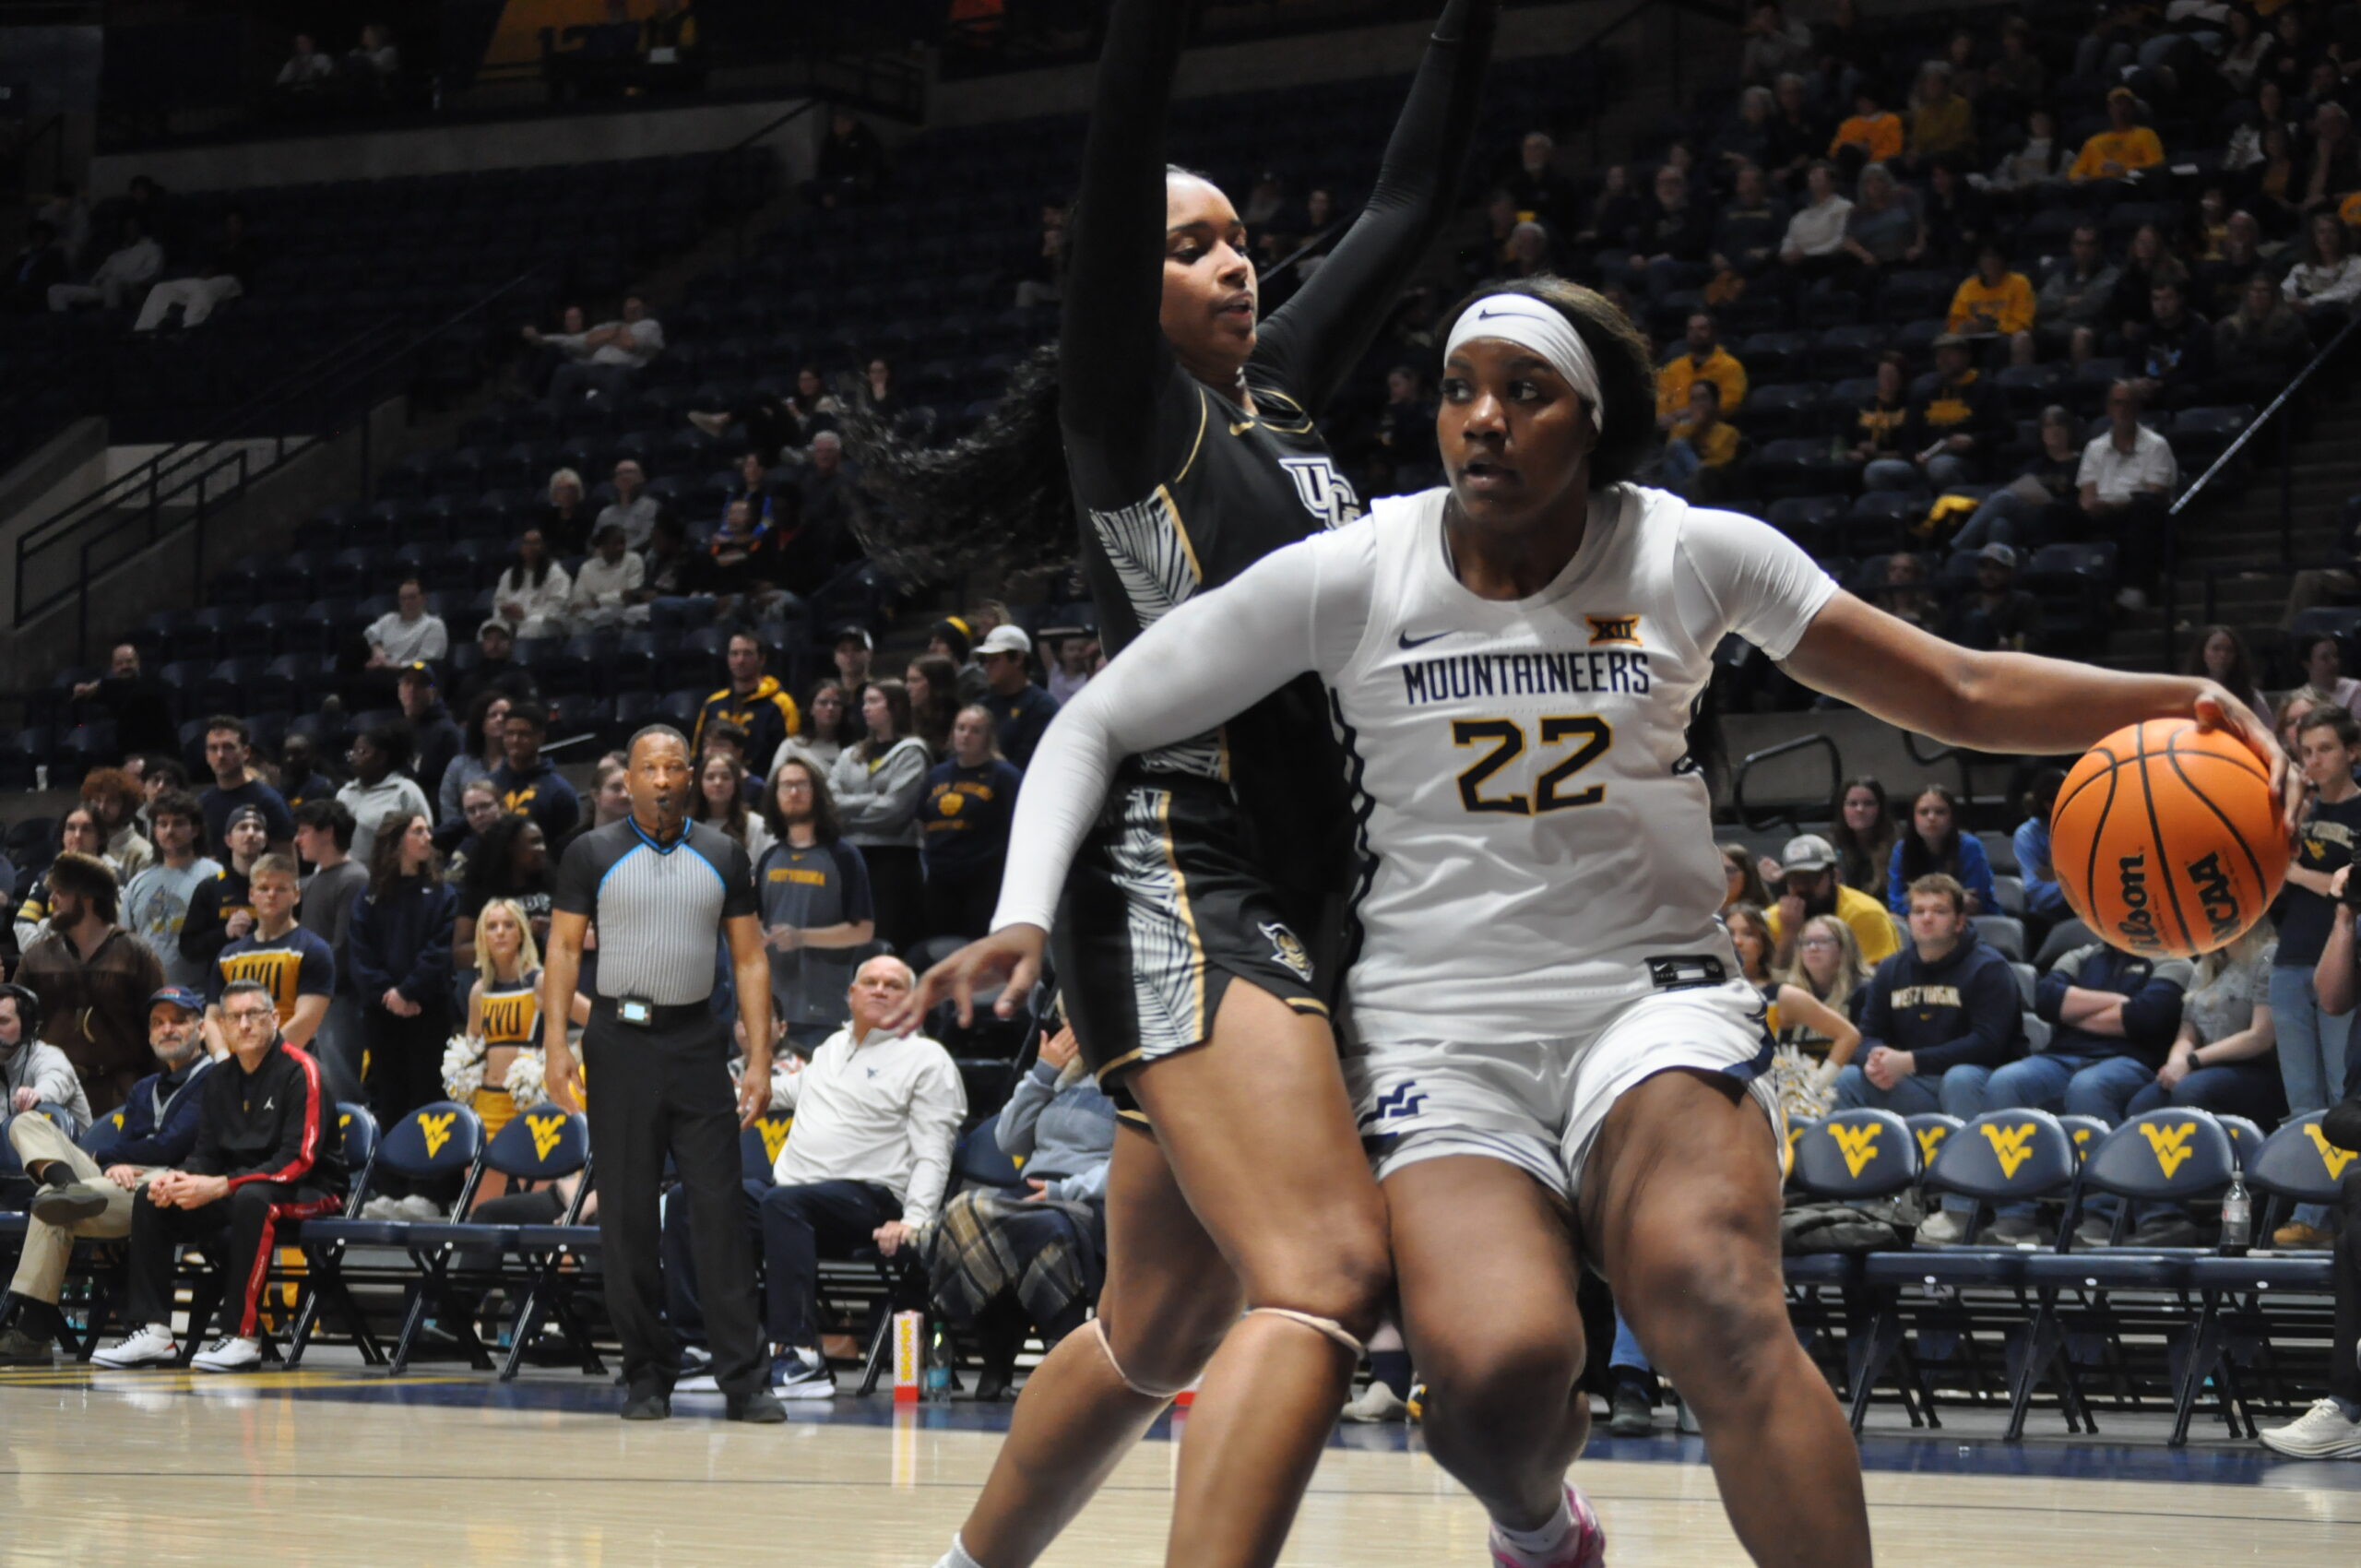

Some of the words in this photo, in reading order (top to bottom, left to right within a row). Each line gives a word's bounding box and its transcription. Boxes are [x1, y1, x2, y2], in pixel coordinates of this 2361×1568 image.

[1402, 651, 1650, 705] MOUNTAINEERS
[1450, 714, 1612, 816] 22
[2118, 853, 2169, 955] ilson
